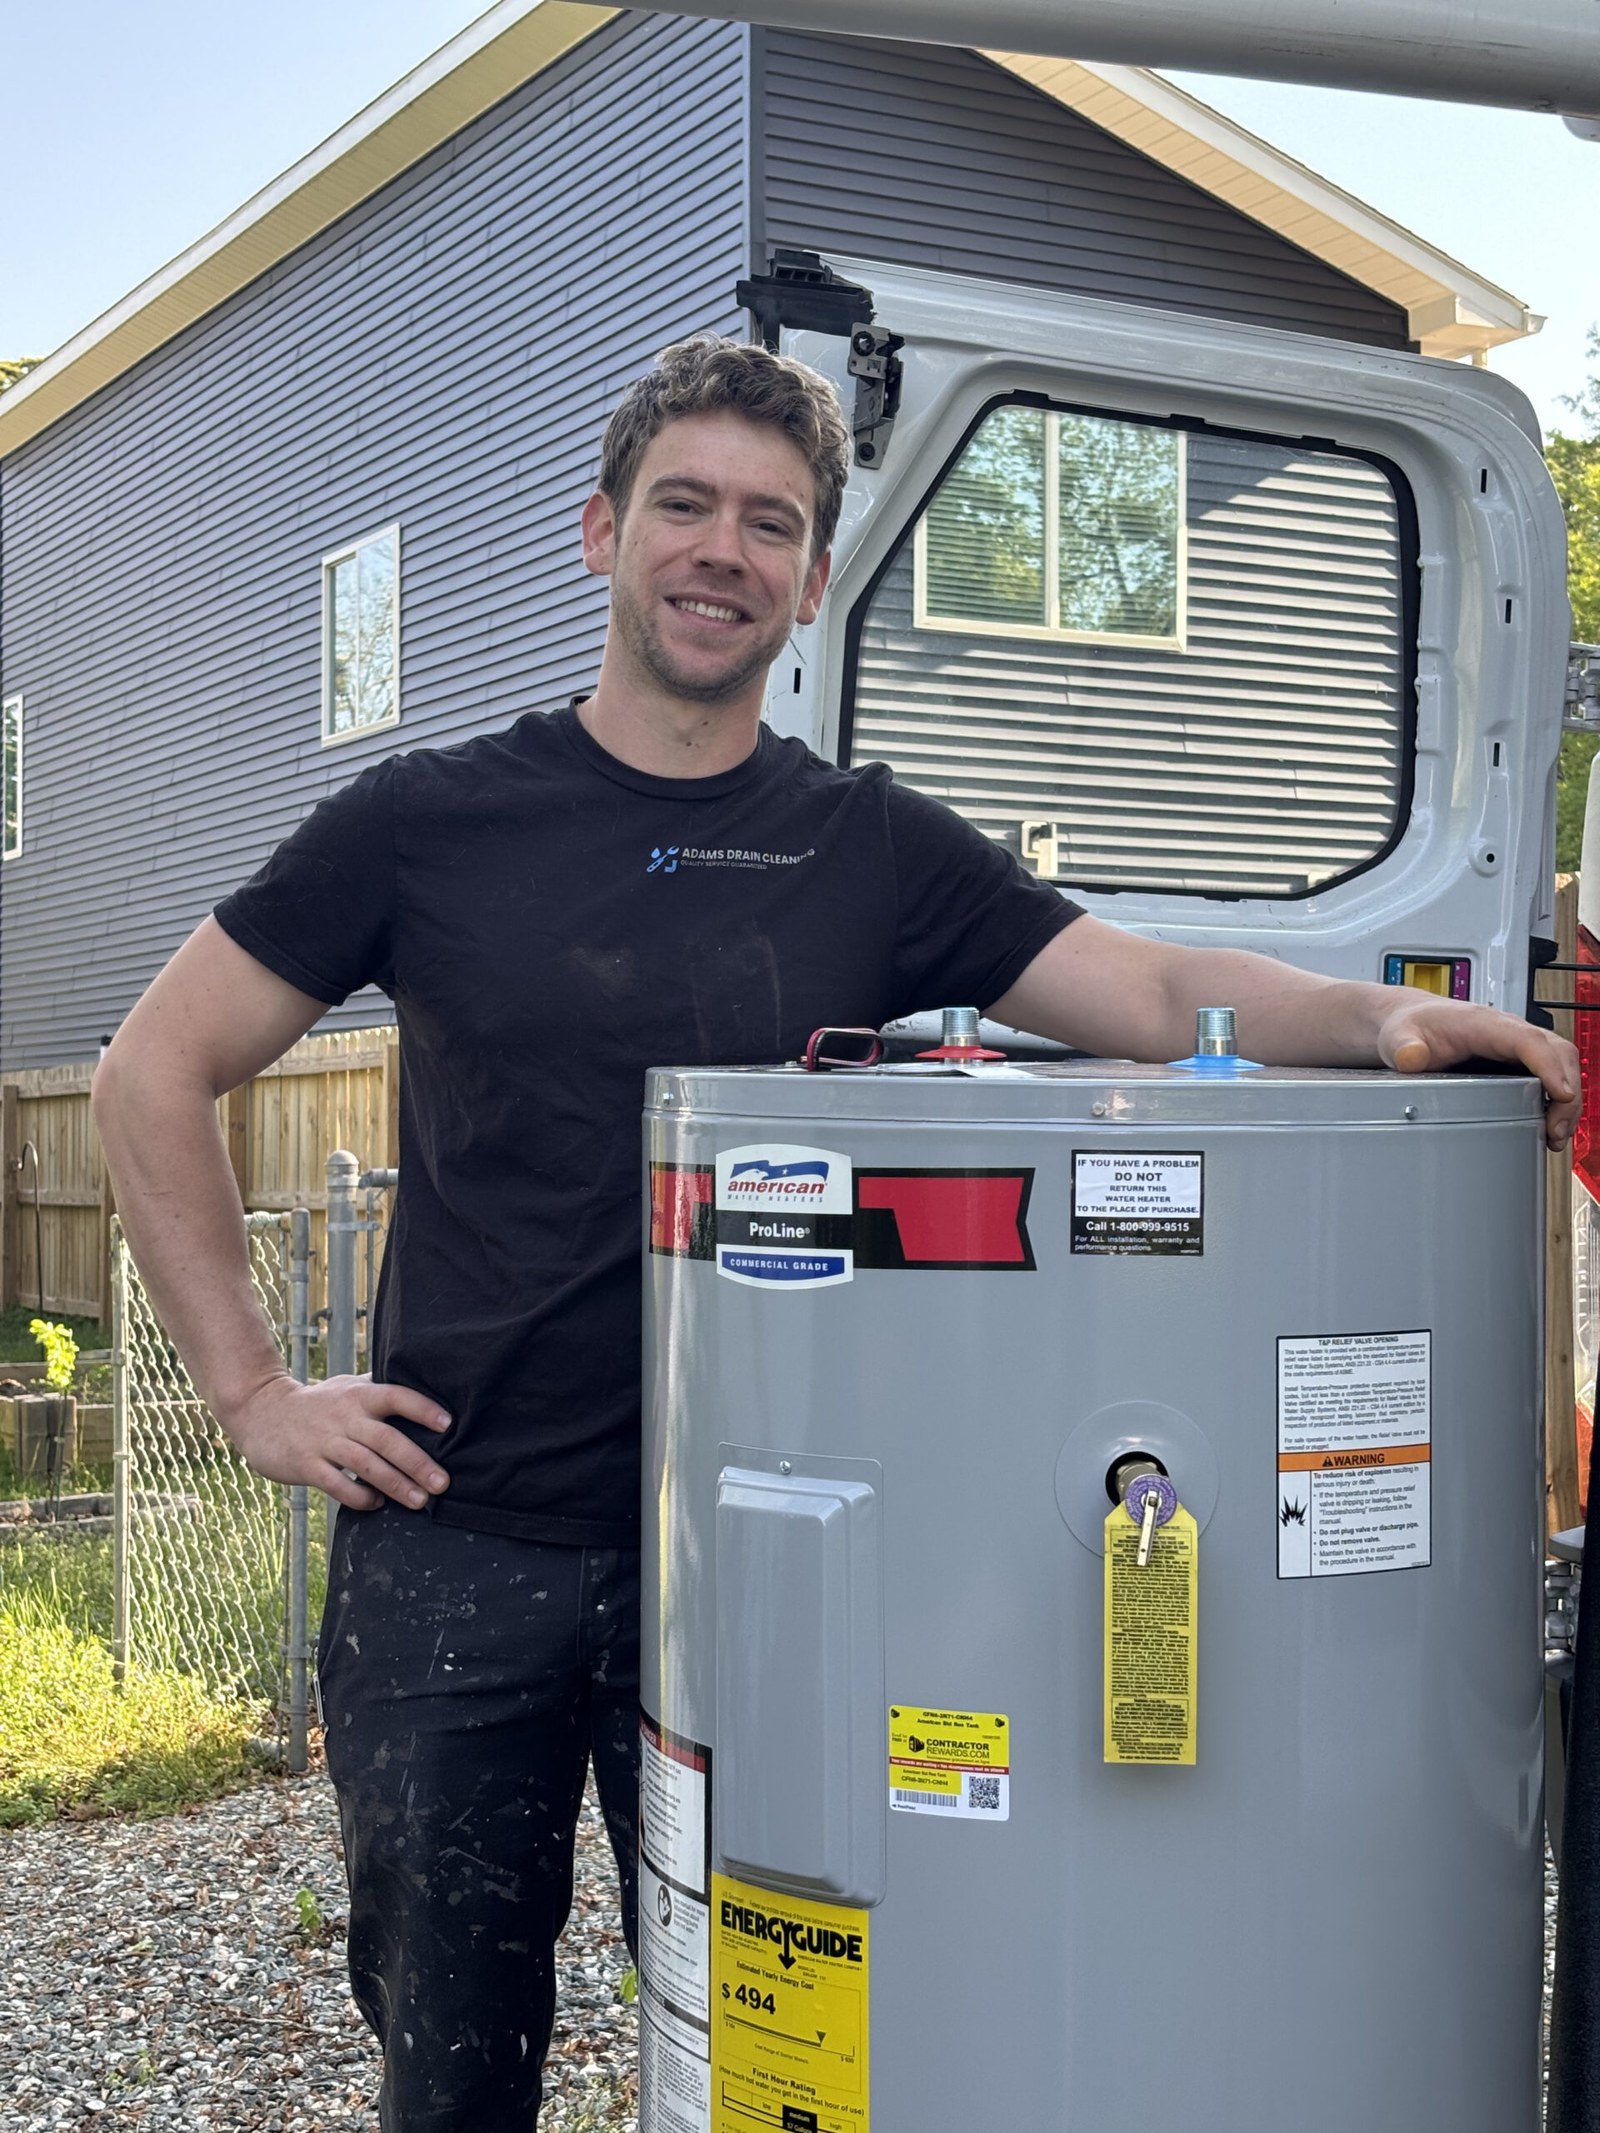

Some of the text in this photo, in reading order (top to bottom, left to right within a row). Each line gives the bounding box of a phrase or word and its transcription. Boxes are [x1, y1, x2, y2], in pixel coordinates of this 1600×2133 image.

[682, 848, 724, 859] ADAMS
[727, 849, 760, 862] DRAIN
[1078, 1159, 1199, 1168] IF YOU HAVE A PROBLEM
[1115, 1172, 1163, 1182] DO NOT
[728, 1181, 825, 1194] american
[1152, 1206, 1199, 1214] PURCHASE.
[1086, 1220, 1190, 1232] Call 1-800-999-9515
[1090, 1235, 1105, 1243] ALL
[1152, 1237, 1184, 1245] warranty
[730, 1258, 829, 1271] COMMERCIAL GRADE
[1334, 1453, 1385, 1466] WARNING
[926, 1738, 989, 1751] CONTRACTOR
[926, 1746, 990, 1760] REWARDS.COM
[736, 1960, 814, 1990] Estimated Yearly Energy Cost
[721, 1982, 776, 2015] $ 494
[752, 2067, 816, 2096] First Hour Rating
[731, 2070, 745, 2081] much
[746, 2075, 754, 2085] hot
[755, 2080, 769, 2090] water
[770, 2085, 781, 2094] you
[782, 2089, 792, 2098] get
[793, 2091, 799, 2099] in
[799, 2093, 810, 2103] the
[811, 2096, 823, 2106] first
[824, 2099, 840, 2111] hour
[840, 2104, 849, 2112] of
[849, 2106, 864, 2117] use)
[789, 2111, 810, 2123] medium
